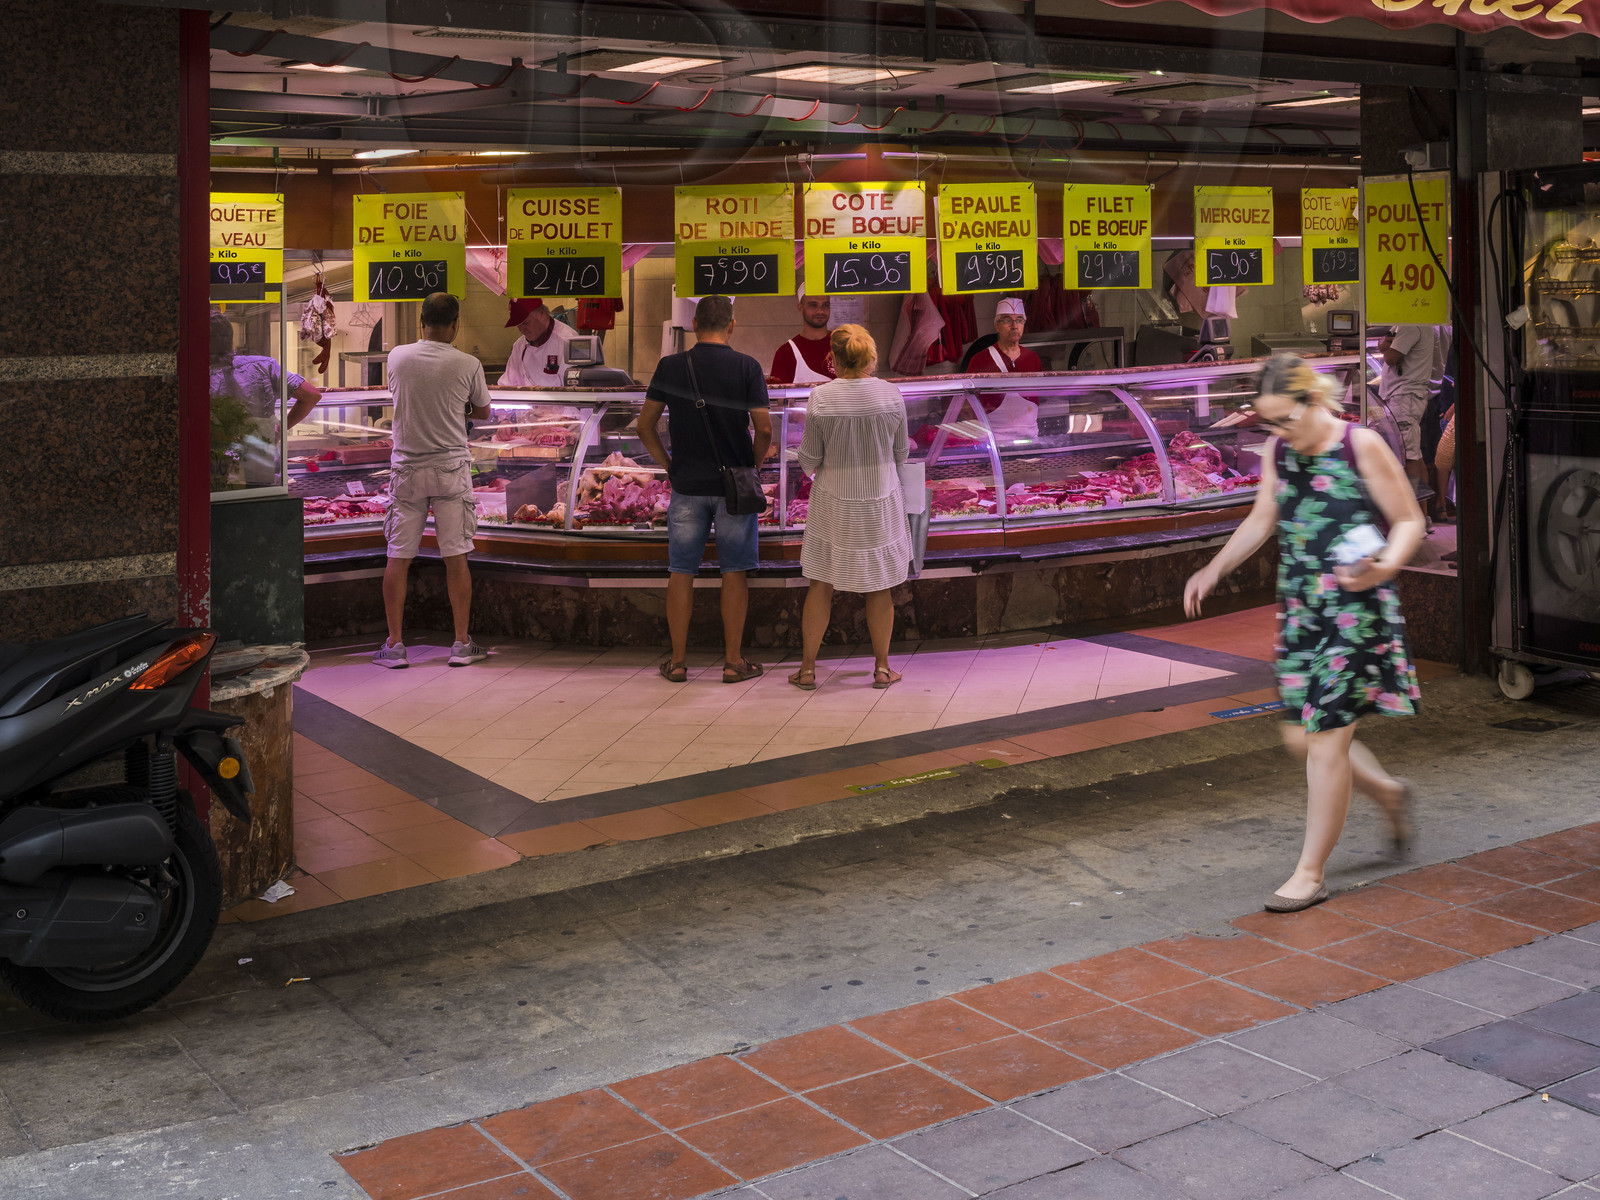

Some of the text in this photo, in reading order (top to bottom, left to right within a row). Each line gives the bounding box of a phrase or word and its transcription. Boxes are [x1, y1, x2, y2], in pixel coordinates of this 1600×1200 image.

[522, 198, 600, 216] CUISSE
[706, 197, 758, 215] ROTI
[832, 193, 894, 211] COTE
[951, 195, 1021, 214] EPAULE
[1086, 197, 1134, 213] FILET
[1302, 196, 1332, 210] COTE
[383, 203, 428, 220] FOIE
[1200, 207, 1270, 224] MERGUEZ
[1366, 202, 1444, 223] POULET
[358, 225, 457, 244] DE VEAU
[509, 222, 613, 240] DE POULET
[680, 221, 783, 239] DE DINDE
[806, 217, 836, 235] DE
[942, 220, 1031, 239] D'AGNEAU
[1069, 220, 1091, 236] DE
[221, 232, 266, 247] VEAU
[849, 241, 881, 249] le Kilo
[986, 241, 1001, 250] Kilo
[1093, 241, 1100, 249] le
[1378, 233, 1426, 252] ROTI
[218, 250, 238, 259] Kilo
[404, 249, 422, 257] Kilo
[547, 247, 577, 255] le Kilo
[718, 246, 750, 254] le Kilo
[532, 262, 599, 294] 2,40
